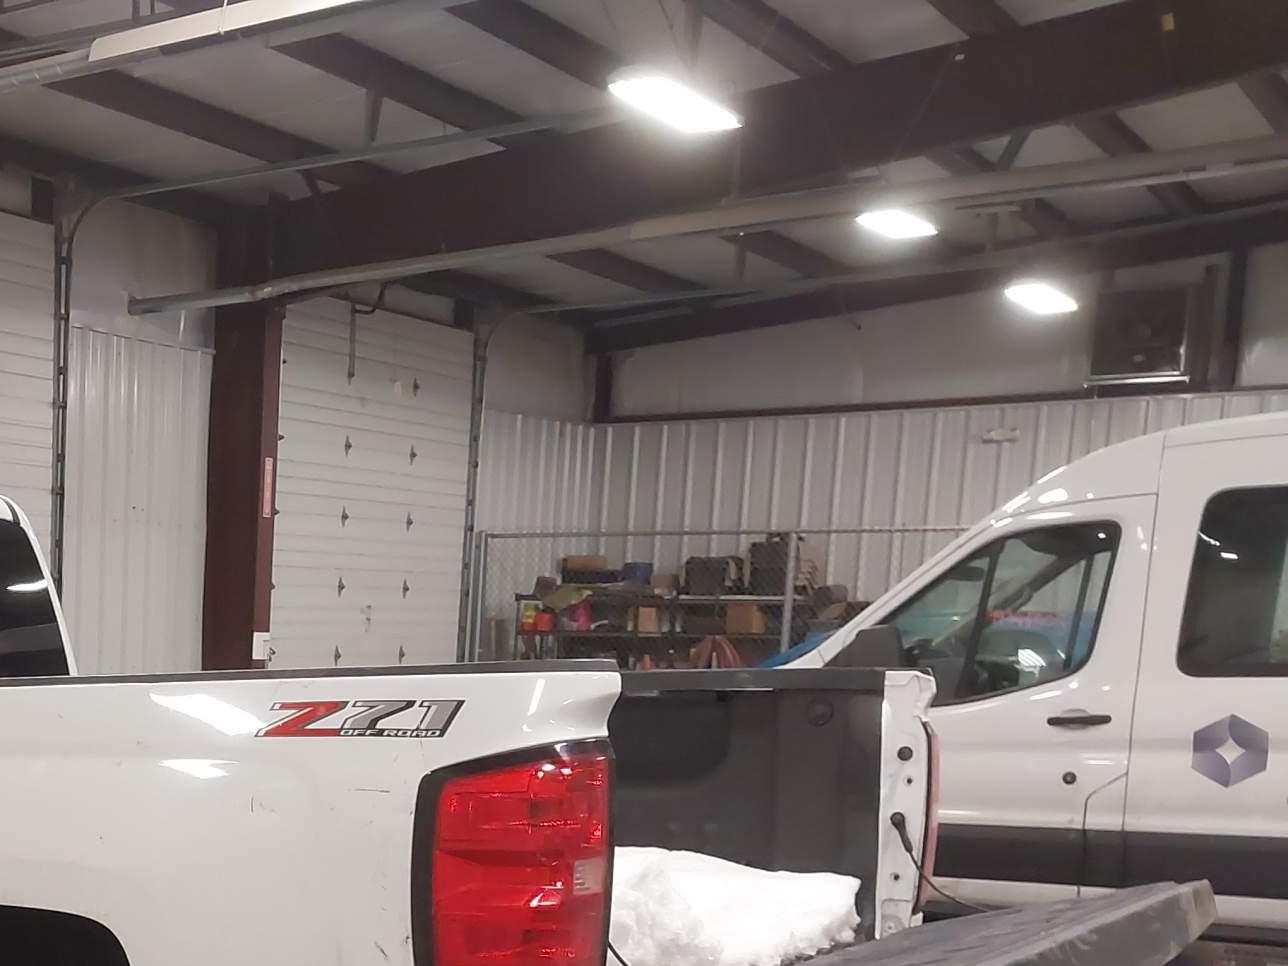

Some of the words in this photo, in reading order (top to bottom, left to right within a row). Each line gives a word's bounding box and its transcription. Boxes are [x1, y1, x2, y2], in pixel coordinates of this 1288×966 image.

[254, 699, 466, 738] Z71
[340, 729, 379, 737] OFF
[382, 729, 441, 737] ROAD
